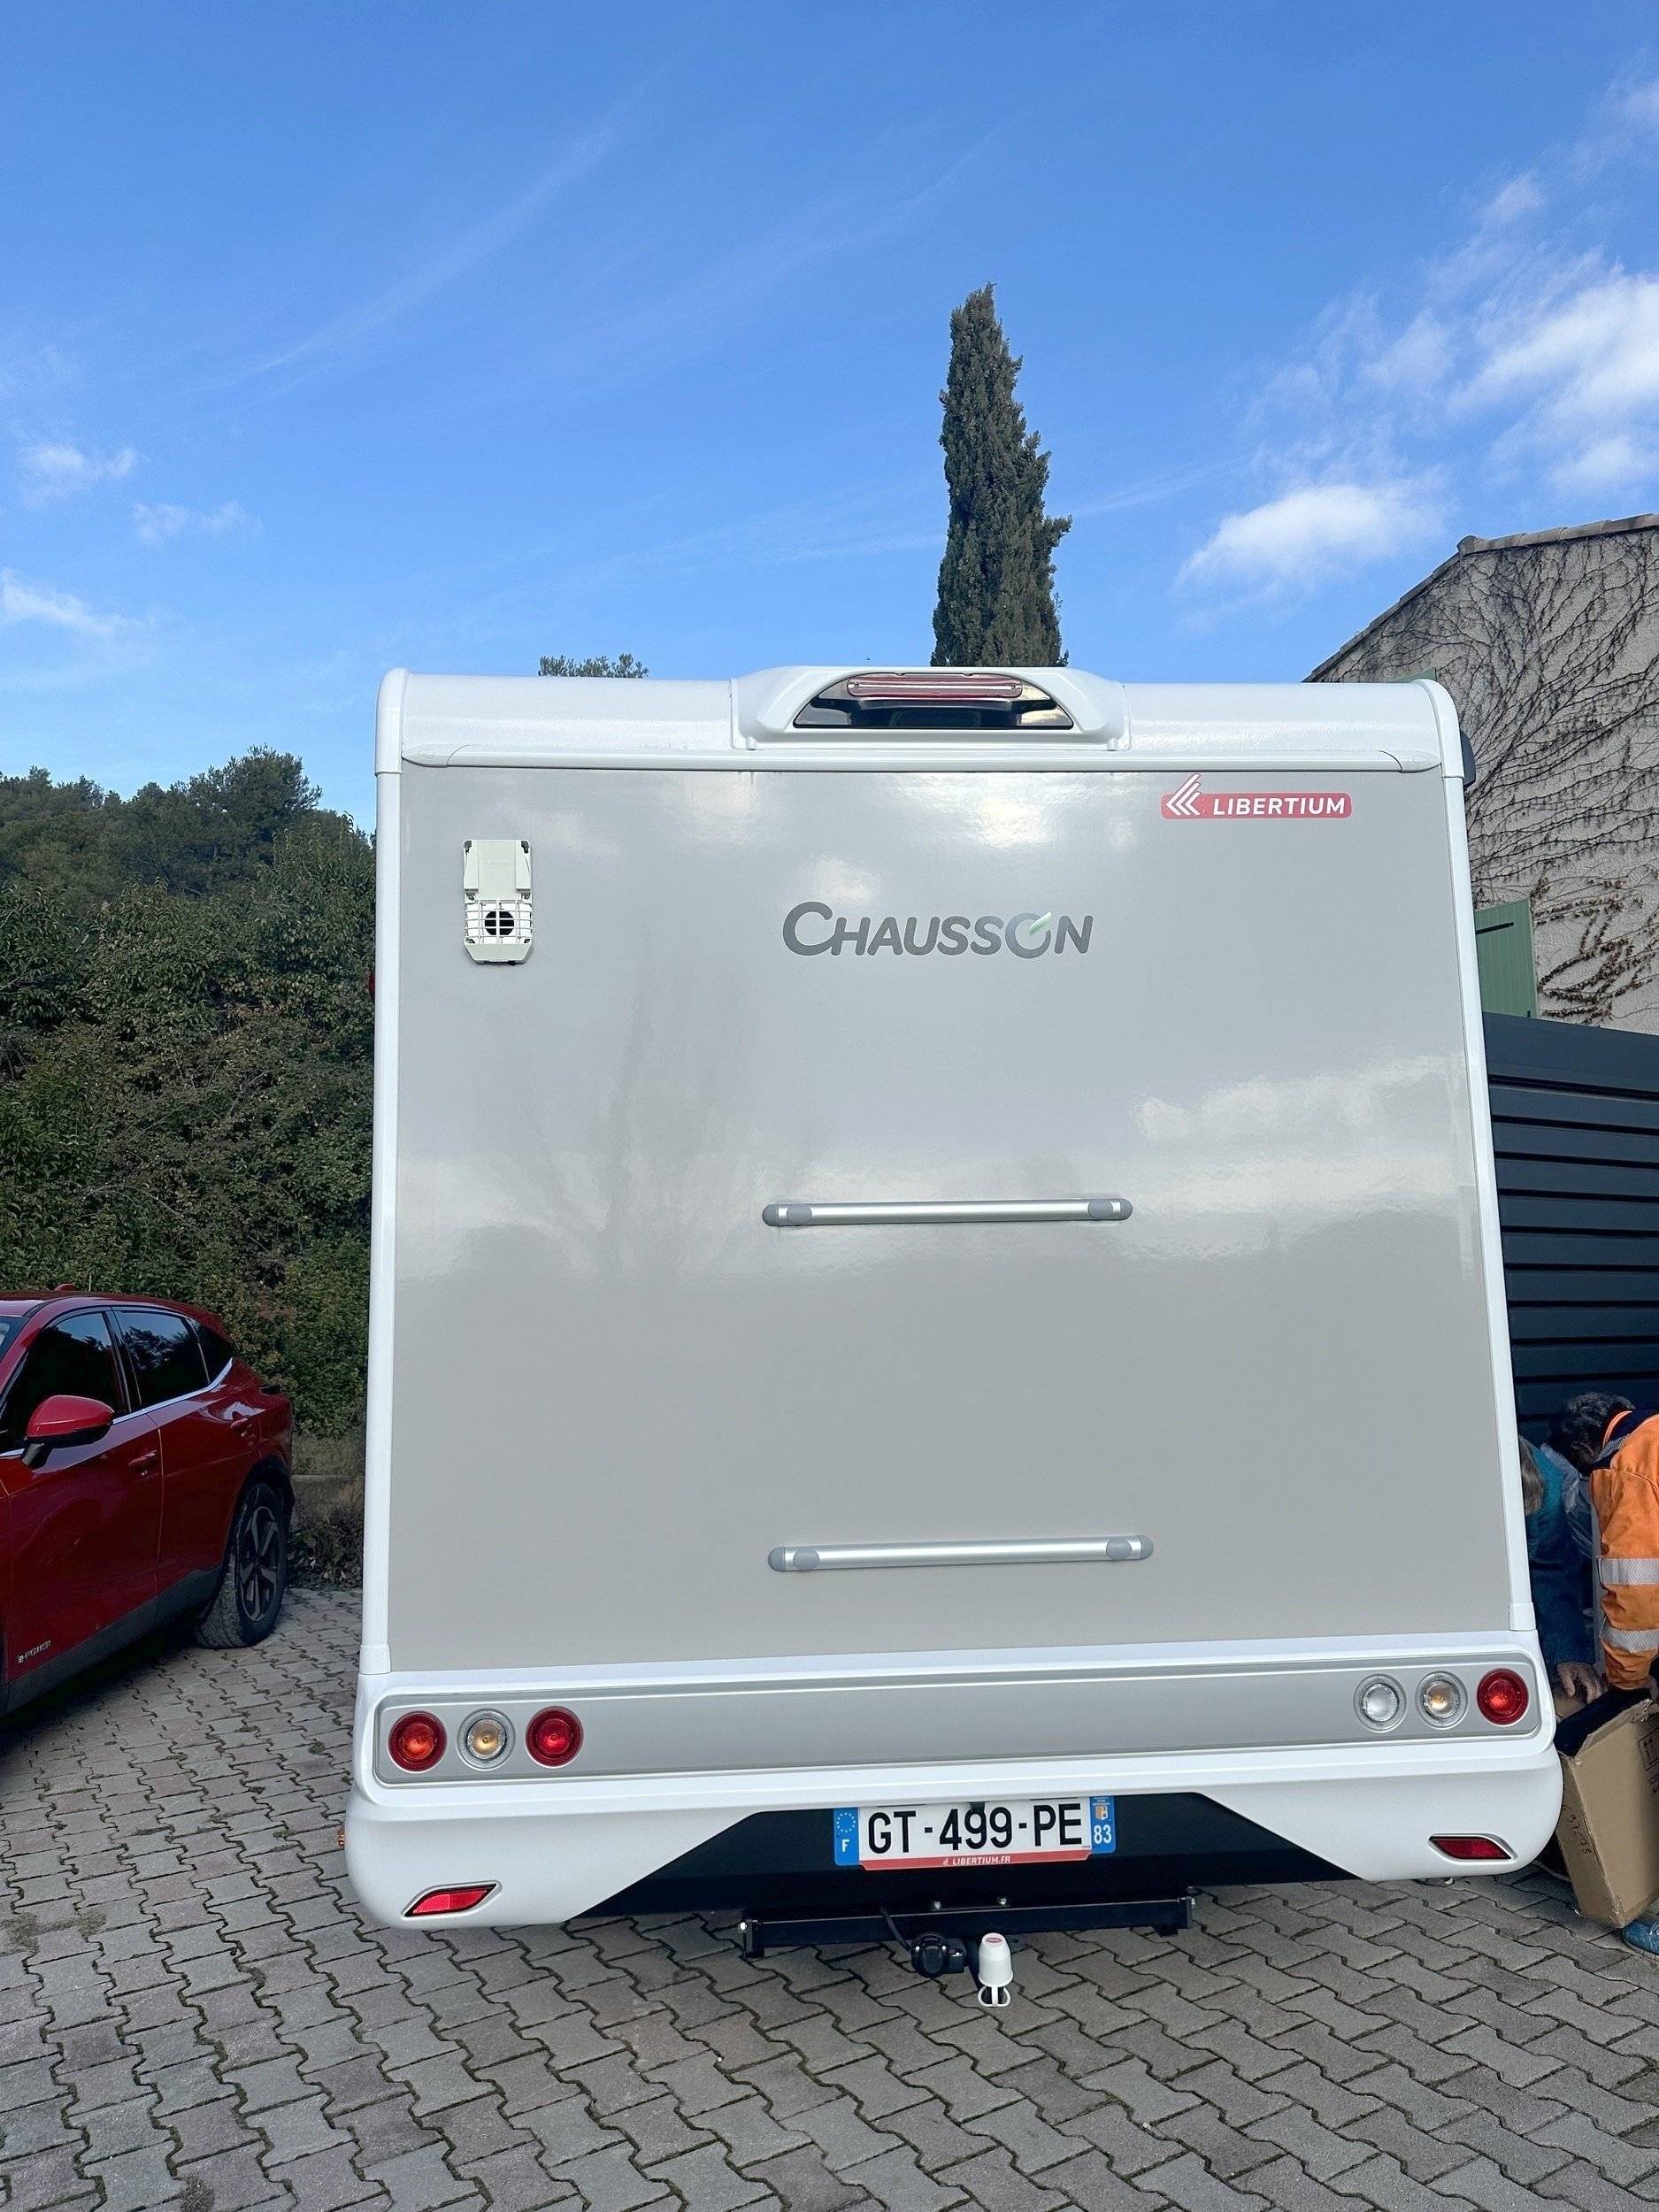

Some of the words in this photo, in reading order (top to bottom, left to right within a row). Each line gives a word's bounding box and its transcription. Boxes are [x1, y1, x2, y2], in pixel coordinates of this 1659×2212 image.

[1213, 797, 1345, 816] LIBERTIUM
[782, 901, 1094, 959] CHAUSSON
[867, 1803, 1083, 1854] GT-499-PE
[1093, 1824, 1112, 1845] 83
[841, 1839, 850, 1853] F
[952, 1855, 1011, 1866] LIBERTIUM.FR
